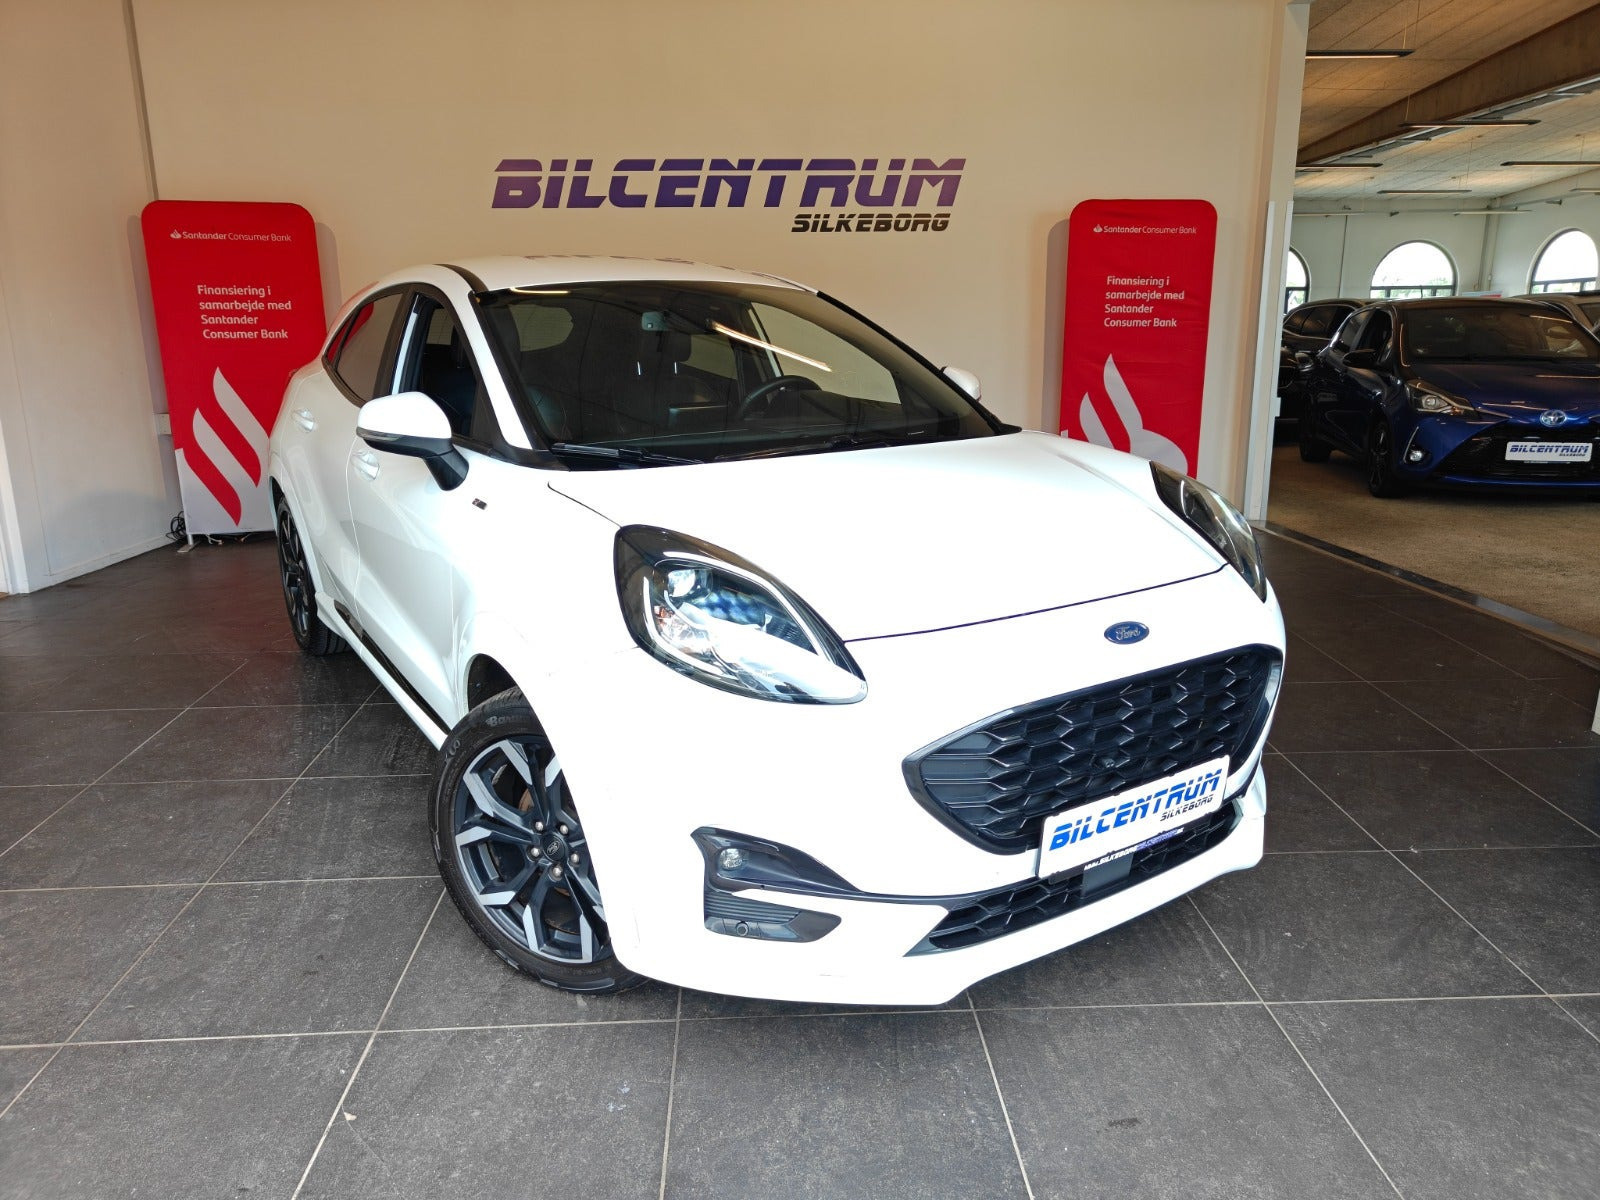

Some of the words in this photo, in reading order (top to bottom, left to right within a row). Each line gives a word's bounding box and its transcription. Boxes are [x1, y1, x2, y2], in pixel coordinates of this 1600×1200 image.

[490, 158, 967, 209] BILCENTRUM
[791, 213, 951, 233] SILKEBORG
[1103, 225, 1142, 234] Santander
[1142, 225, 1178, 234] Consumer
[1179, 226, 1197, 234] Bank
[182, 231, 227, 240] Santander
[228, 232, 270, 242] Consumer
[270, 233, 292, 242] Bank
[1106, 275, 1164, 288] Finansiering
[197, 285, 265, 298] Finansiering
[1105, 290, 1162, 302] samarbejde
[1163, 290, 1185, 300] med
[199, 300, 265, 312] samarbejde
[267, 300, 292, 310] med
[1104, 303, 1154, 313] Santander
[200, 314, 258, 325] Santander
[1103, 317, 1151, 327] Consumer
[1153, 317, 1177, 327] Bank
[202, 328, 258, 339] Consumer
[261, 328, 288, 339] Bank
[1509, 444, 1590, 453] BILCENTRUM
[1049, 768, 1223, 851] BILCENTRUM
[1159, 794, 1214, 822] SILKEBORG
